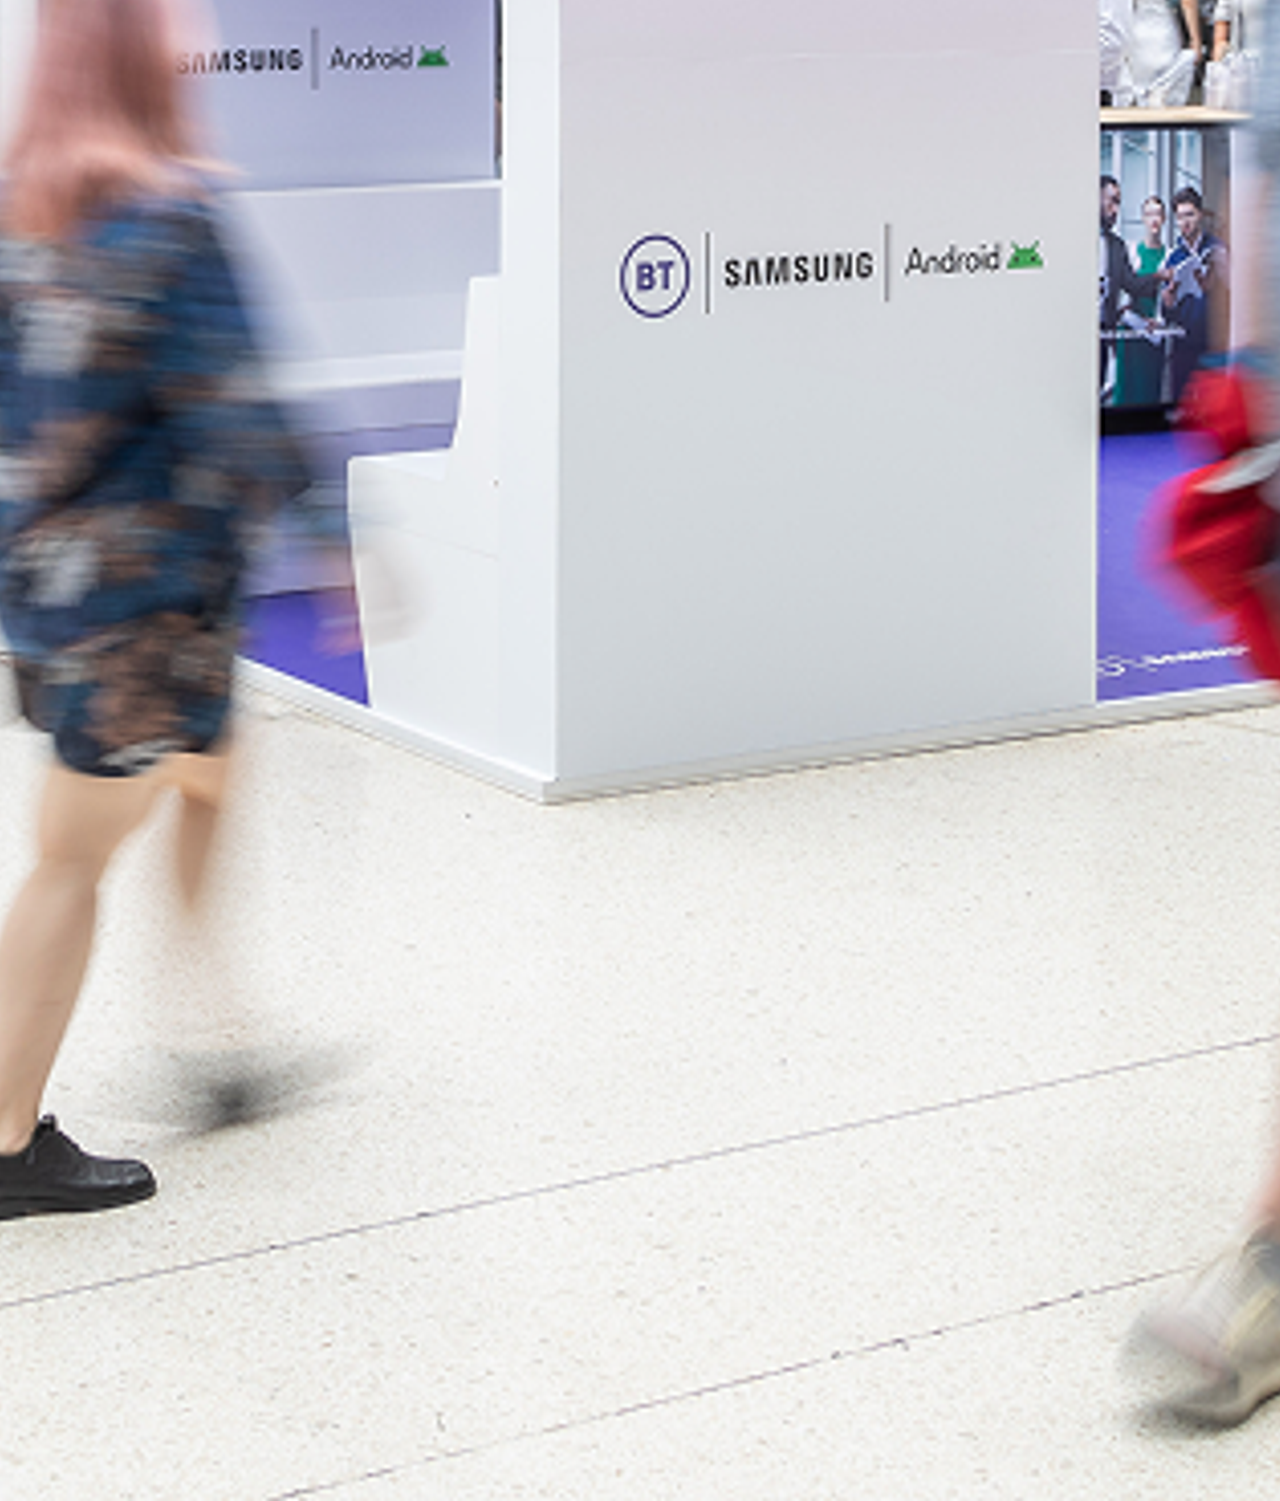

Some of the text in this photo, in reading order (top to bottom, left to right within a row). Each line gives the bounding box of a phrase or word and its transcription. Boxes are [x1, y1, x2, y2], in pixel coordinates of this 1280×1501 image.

[176, 45, 414, 75] SAMSUNG Android
[636, 242, 1002, 291] BT SAMSUNG Android
